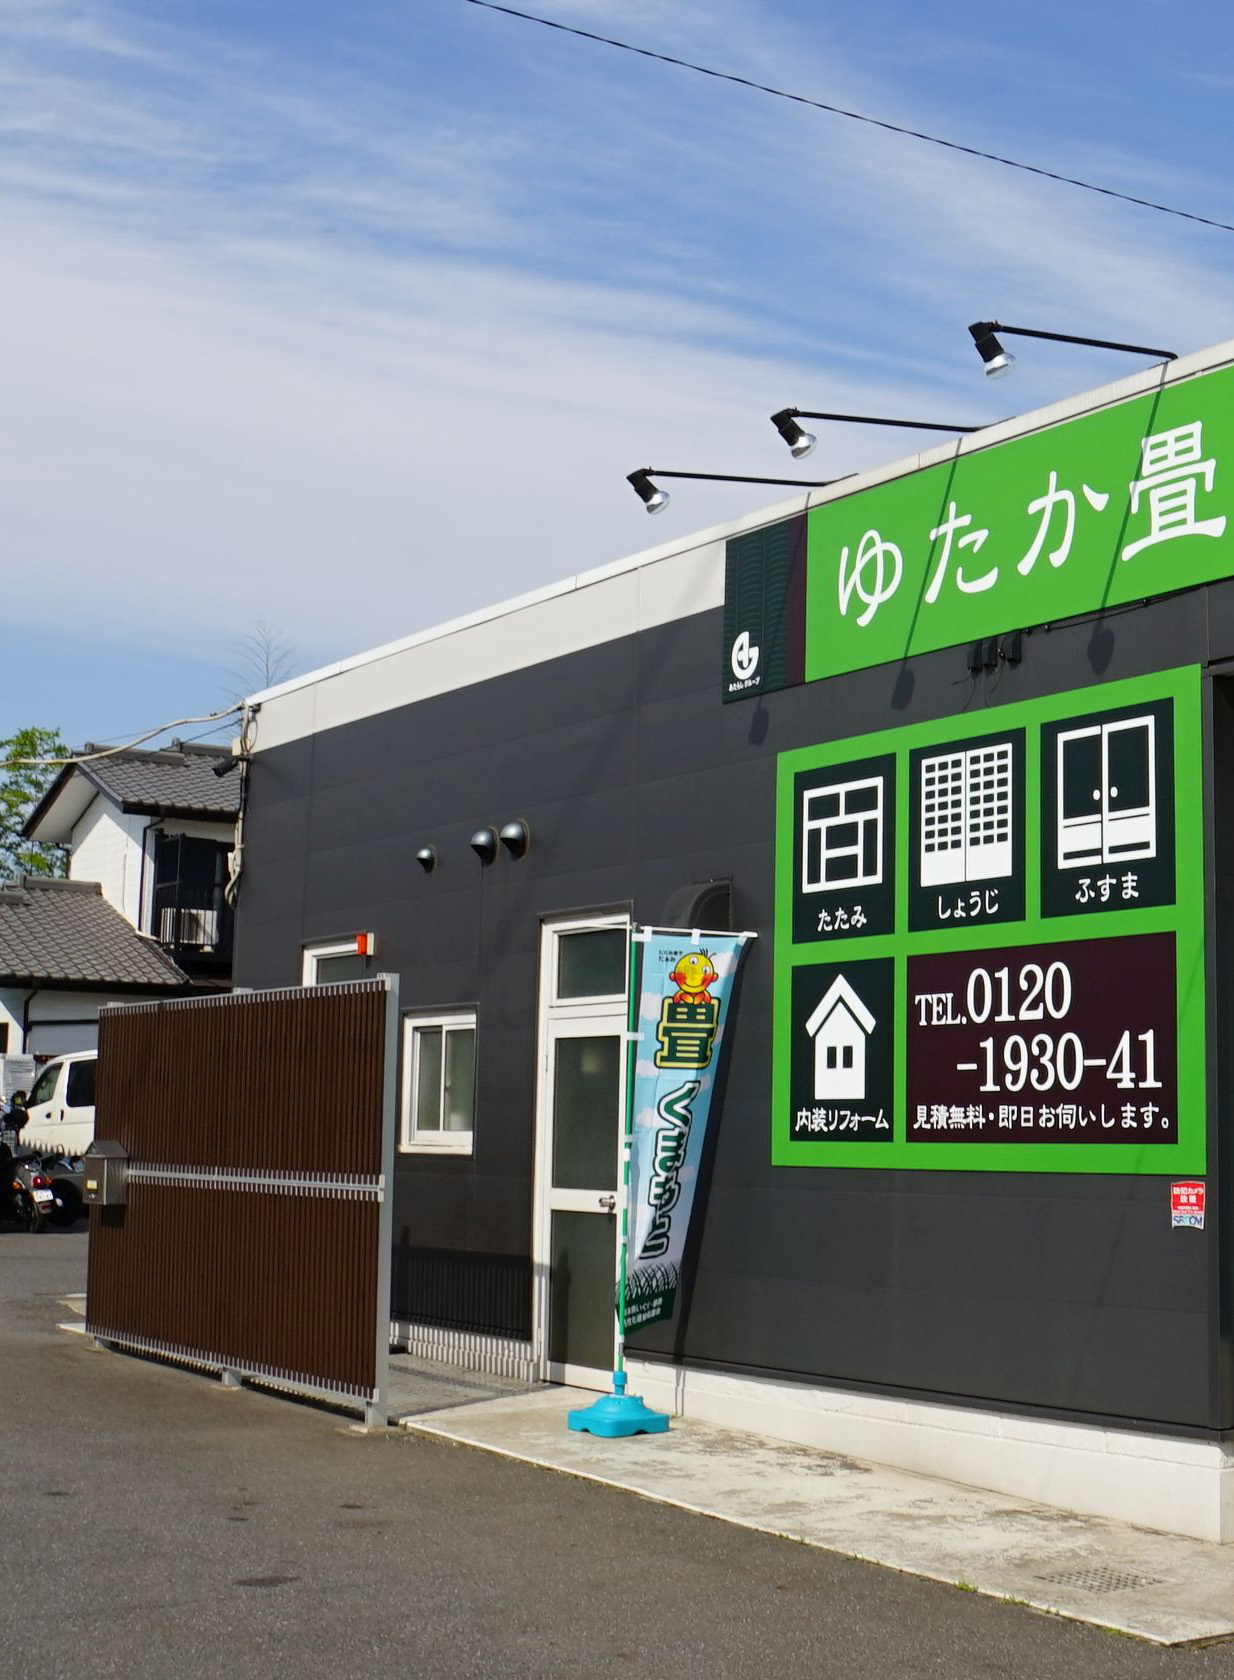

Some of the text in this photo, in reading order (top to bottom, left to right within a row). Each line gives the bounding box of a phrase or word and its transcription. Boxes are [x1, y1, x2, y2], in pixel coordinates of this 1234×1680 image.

[838, 420, 1227, 627] ゆたか畳
[1075, 871, 1139, 903] ふすま
[817, 905, 868, 932] たたみ
[938, 888, 1000, 919] しょうじ
[794, 1107, 890, 1132] 内装リフォーム
